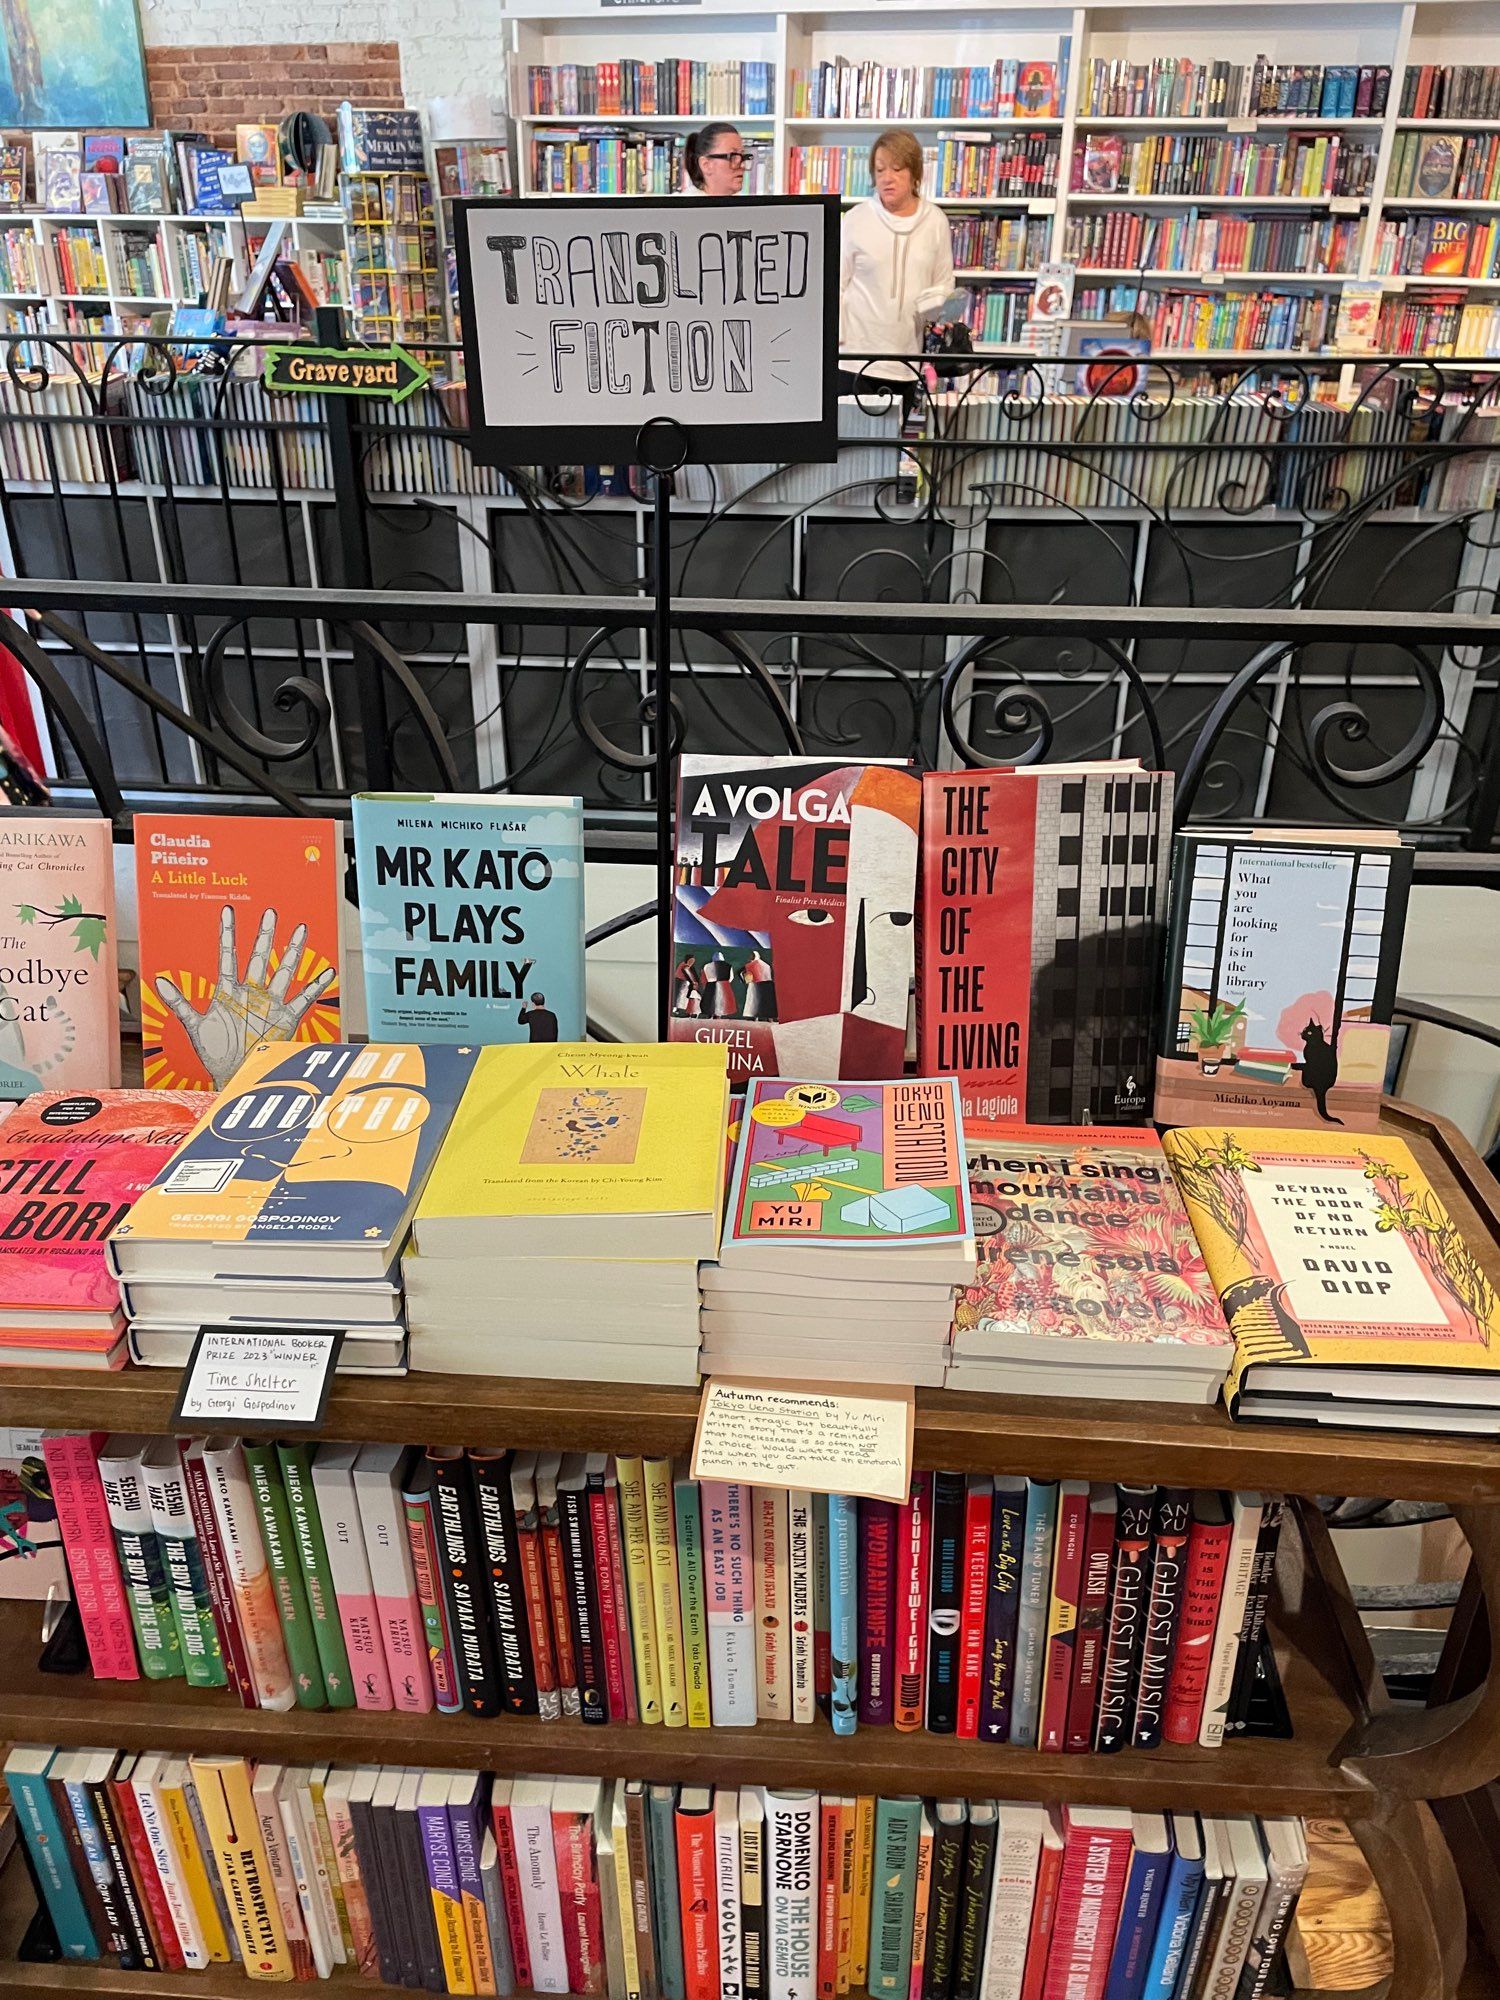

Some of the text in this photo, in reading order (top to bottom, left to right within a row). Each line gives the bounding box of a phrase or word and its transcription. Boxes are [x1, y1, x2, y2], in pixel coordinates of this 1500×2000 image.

[1433, 221, 1467, 241] BIG
[1431, 241, 1465, 254] TREE
[486, 230, 809, 307] TRANSLATED
[550, 319, 753, 395] FICTION
[692, 783, 853, 824] A VOLGA
[942, 786, 991, 836] THE
[397, 819, 527, 832] MILENA MICHIKO FLAŠAR
[0, 832, 87, 848] ARIKAWA
[150, 833, 211, 849] Claudia
[17, 861, 86, 872] Cat Chronicles
[150, 851, 209, 867] Piñeiro
[375, 845, 553, 891] MR KATŌ
[690, 821, 849, 895] TALE
[1239, 857, 1337, 870] International bestseller
[151, 871, 248, 887] A Little Luck
[941, 847, 999, 897] CITY
[1238, 872, 1271, 885] What
[775, 895, 845, 907] Finalist Prix Médicis
[1235, 889, 1257, 901] you
[1233, 904, 1253, 913] are
[404, 902, 525, 944] PLAYS
[940, 907, 972, 956] OF
[1232, 917, 1278, 932] looking
[1, 937, 27, 950] The
[1230, 932, 1248, 943] for
[1229, 947, 1253, 958] is in
[1227, 961, 1247, 973] the
[394, 956, 535, 1000] FAMILY
[1225, 975, 1268, 991] library
[938, 965, 986, 1014] THE
[0, 996, 50, 1022] Cat
[695, 1027, 754, 1049] GUZEL
[937, 1021, 1020, 1071] LIVING
[590, 1052, 649, 1060] Myeong-kwan
[559, 1064, 640, 1079] Whale
[963, 1074, 1019, 1090] novel
[892, 1085, 944, 1102] TOKYO
[1113, 1094, 1146, 1107] Europa
[1213, 1093, 1301, 1108] Michiko Aoyama
[220, 1094, 421, 1132] SHELTER
[894, 1101, 945, 1122] UENO
[976, 1096, 1019, 1119] Lagioia
[6, 1129, 132, 1149] Guadalupe
[894, 1123, 949, 1183] STATION
[601, 1176, 643, 1184] Chi-Young
[1062, 1158, 1070, 1175] i
[1081, 1160, 1173, 1185] sing,
[968, 1181, 1161, 1205] mountains
[1275, 1184, 1348, 1195] BEYOND
[770, 1205, 802, 1214] YU
[1271, 1197, 1364, 1209] THE DOOR
[170, 1213, 341, 1224] GEORGI GOSPODINOV
[758, 1217, 812, 1227] MIRI
[1006, 1204, 1129, 1229] dance
[1295, 1212, 1353, 1222] OF NO
[1294, 1226, 1368, 1237] RETURN
[977, 1243, 1081, 1267] irene
[1302, 1258, 1393, 1274] DAVID
[1321, 1279, 1393, 1295] DIOP
[208, 1337, 327, 1348] INTERNATIONAL BOOKER
[206, 1351, 317, 1361] PRIZE 2023 WINNER
[207, 1371, 297, 1389] Time Shelter
[190, 1398, 295, 1412] by Georgi Gospodinov
[715, 1389, 840, 1409] Autumn recommends:
[710, 1399, 886, 1423] Tokyo Ueno Station by Yu Miri
[104, 1480, 121, 1507] HASE
[120, 1475, 141, 1511] SEISHU
[1159, 1503, 1189, 1519] AN
[336, 1522, 349, 1544] OUT
[625, 1480, 645, 1566] SHE AND HER CAT
[1160, 1517, 1186, 1531] YU
[253, 1464, 296, 1621] MIEKO KAWAKAMI HEAVEN
[712, 1509, 726, 1601] AS AN EASY JOB
[728, 1484, 743, 1623] THERE'S NO SUCH THING
[438, 1484, 484, 1681] EARTHLINGS SAYAKA MURATA
[1087, 1552, 1109, 1595] OWLISH
[965, 1525, 986, 1678] THE VEGETARIAN HAN KANG
[1139, 1562, 1179, 1725] GHOST MUSIC
[426, 1816, 457, 1890] MARYSE CONDÉ
[240, 1850, 278, 1955] RETROSPECTIVE
[775, 1811, 793, 1977] STARNONE ON VIA GEMITO
[791, 1811, 811, 1978] DOMENICO THE HOUSE
